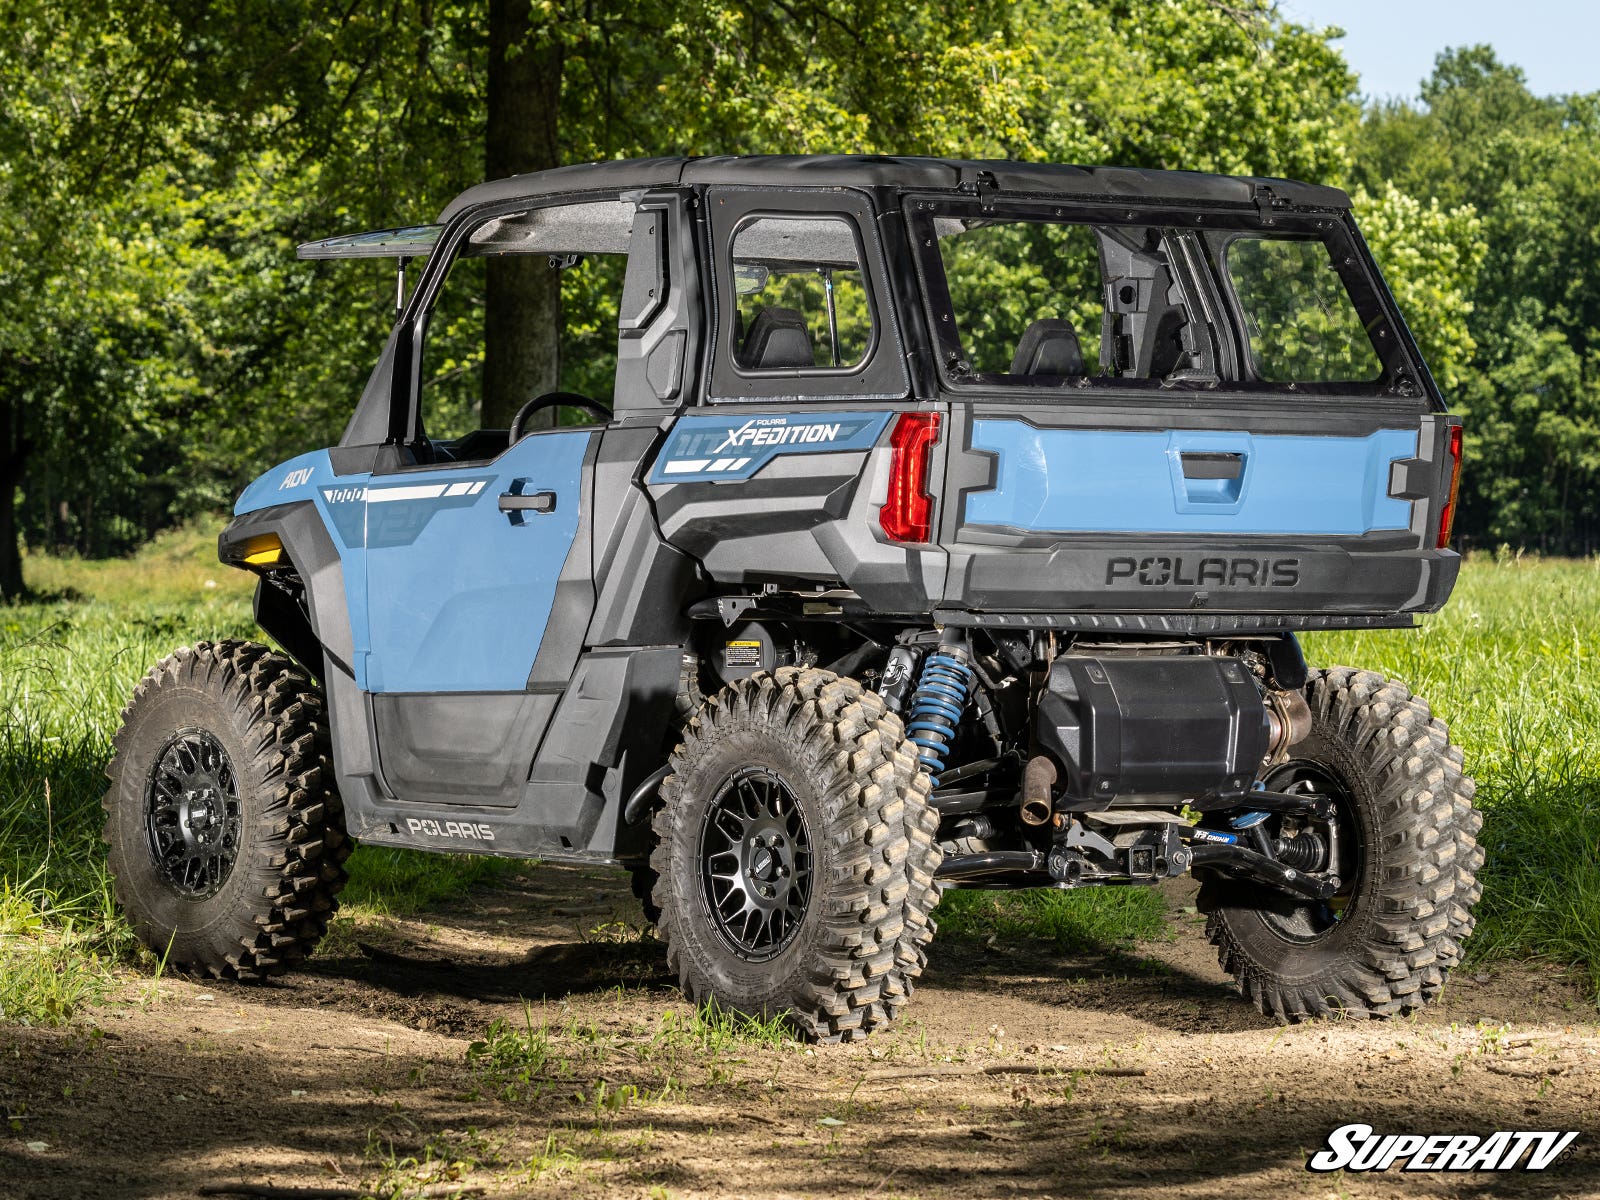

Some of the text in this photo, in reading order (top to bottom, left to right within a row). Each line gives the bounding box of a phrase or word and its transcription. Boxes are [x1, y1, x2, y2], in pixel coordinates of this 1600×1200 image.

[757, 418, 787, 426] POLARIS
[713, 419, 841, 454] XPEDITION
[279, 466, 314, 490] ADV
[1105, 557, 1300, 587] POLARIS
[407, 818, 495, 841] POLARIS
